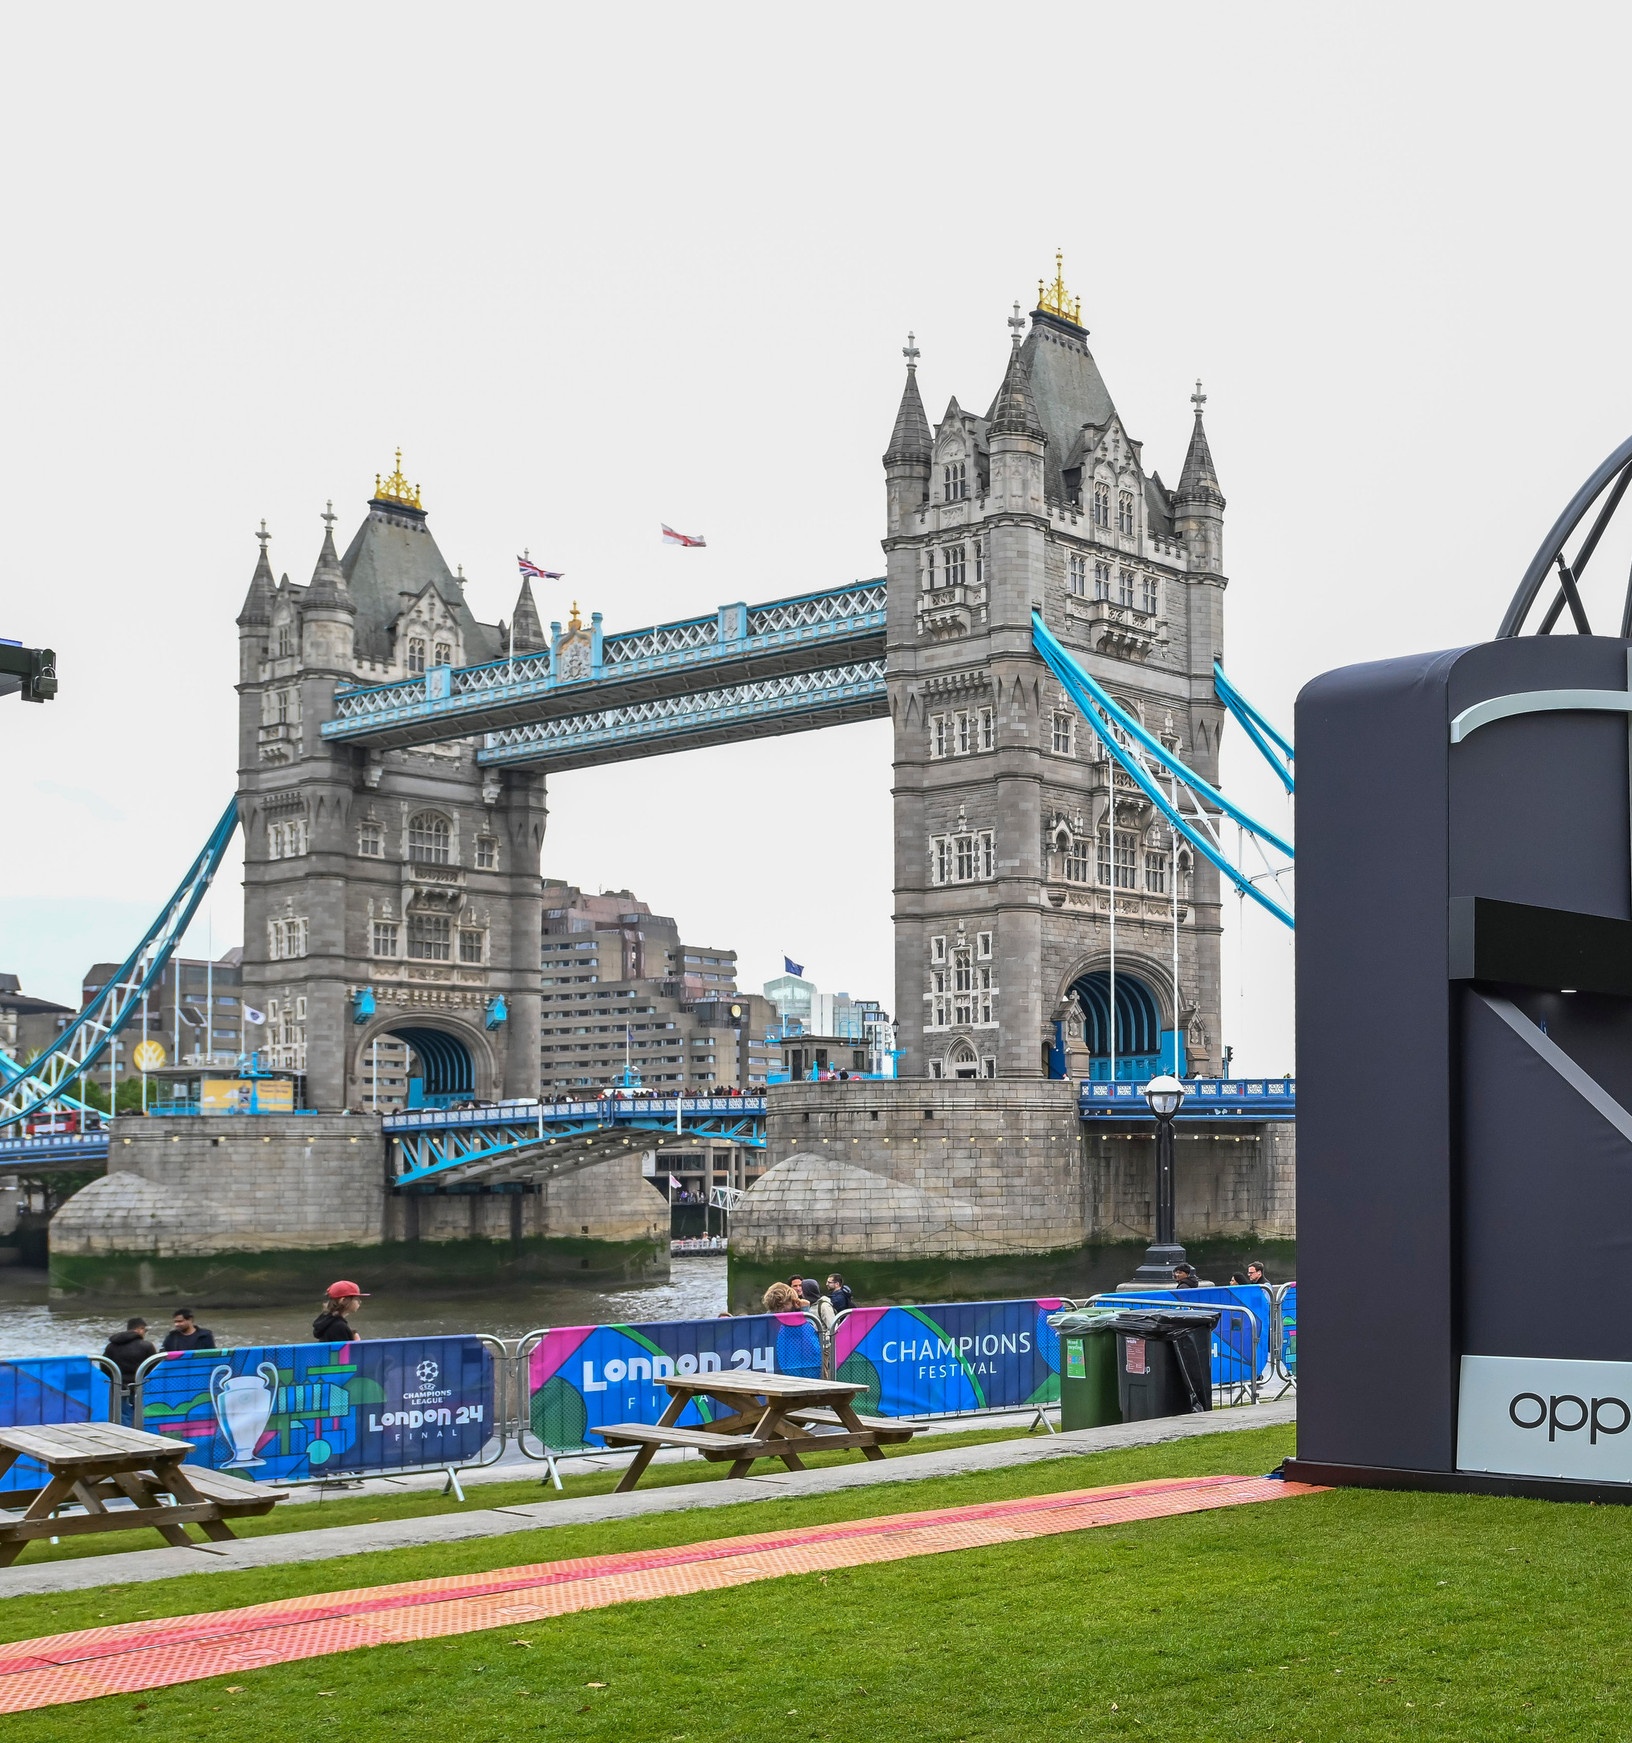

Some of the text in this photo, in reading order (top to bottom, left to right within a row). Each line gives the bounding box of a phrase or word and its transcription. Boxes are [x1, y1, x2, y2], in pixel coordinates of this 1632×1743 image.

[882, 1332, 1031, 1363] CHAMPIONS
[731, 1346, 774, 1374] 24
[919, 1361, 997, 1380] FESTIVAL
[403, 1389, 452, 1399] CHAMPIONS
[418, 1382, 436, 1391] UEFA
[411, 1397, 443, 1405] LEAGUE
[456, 1404, 484, 1424] 24
[395, 1429, 457, 1441] FINAL
